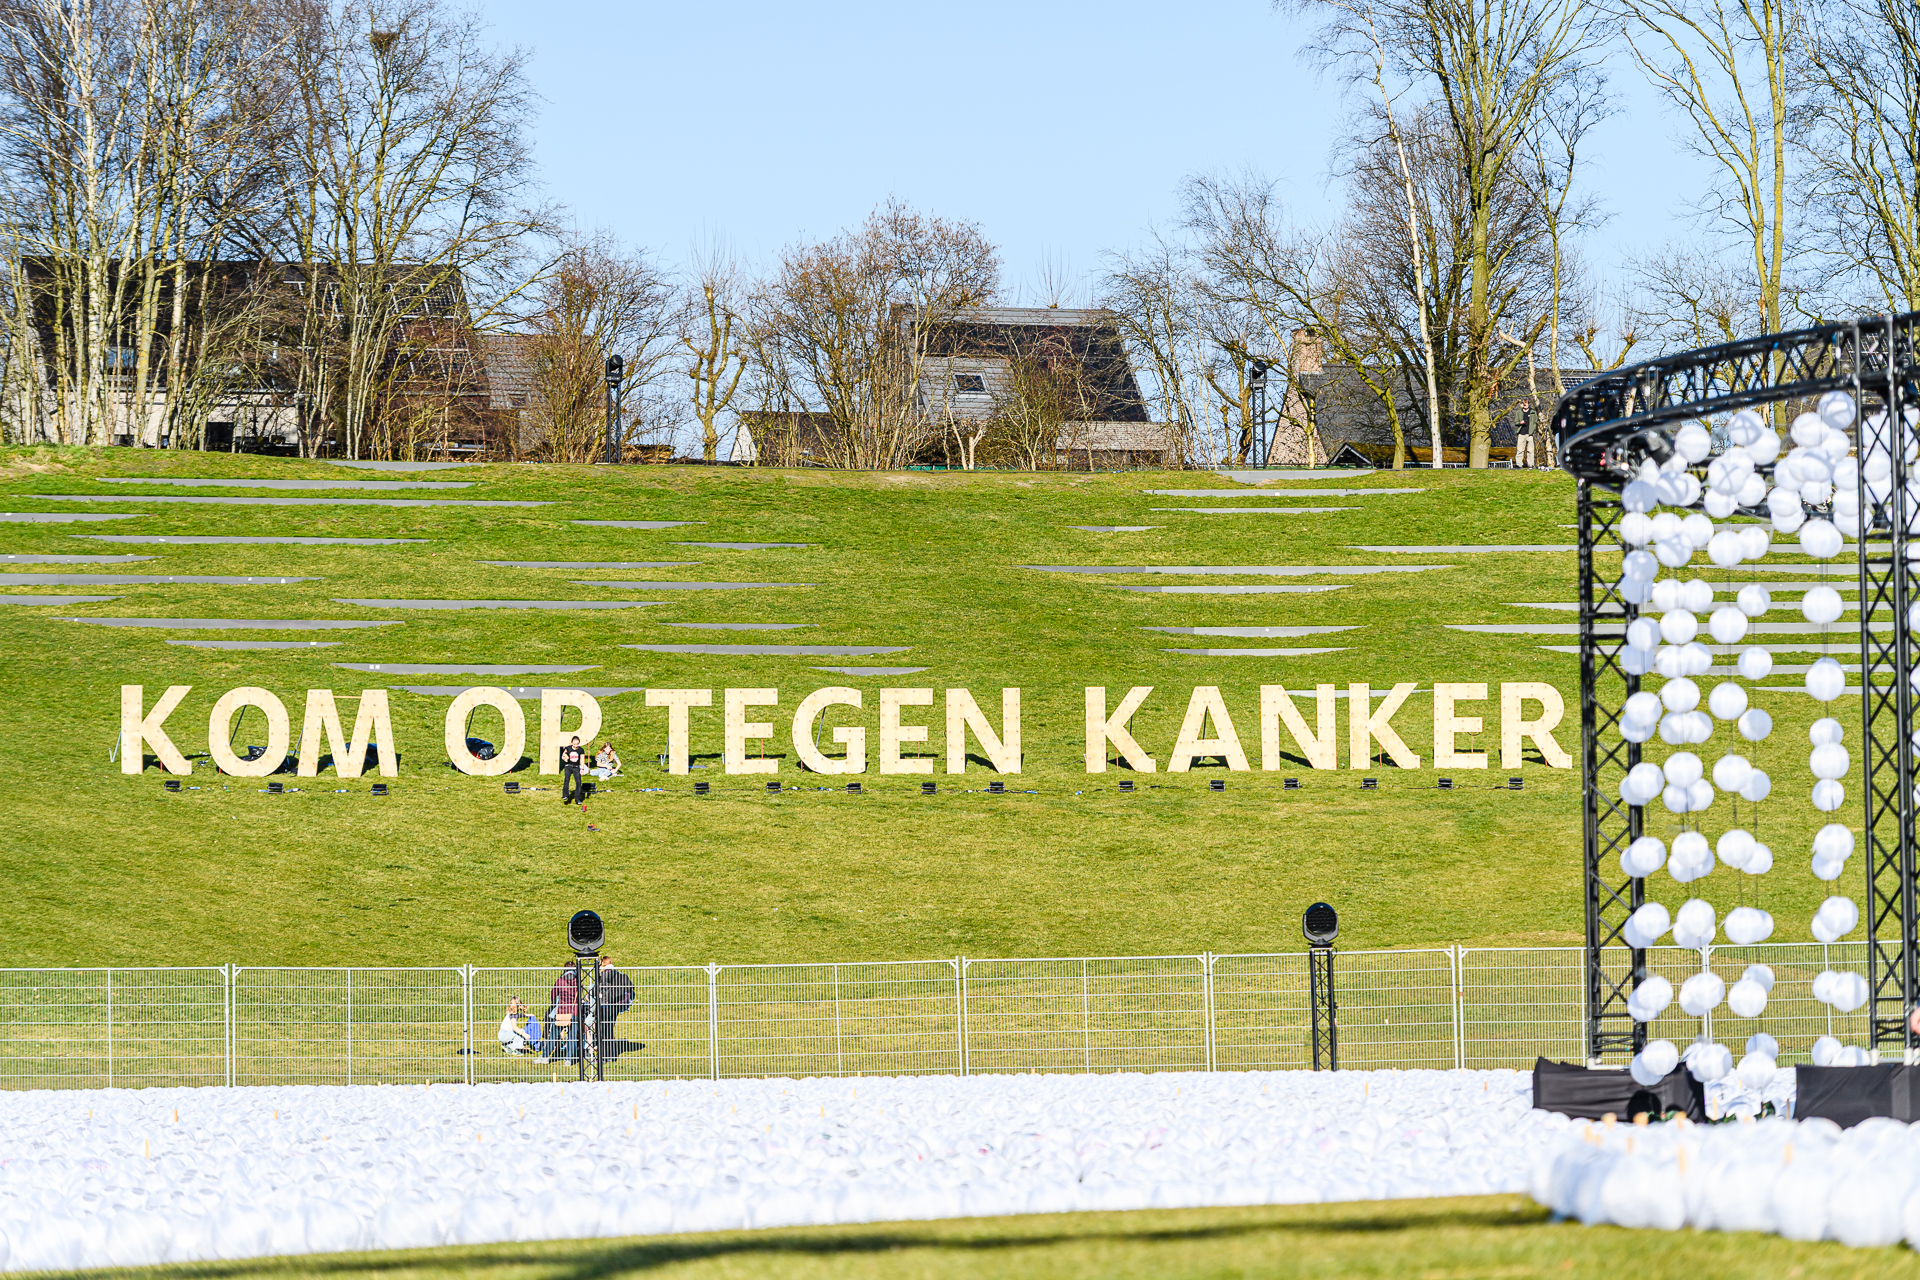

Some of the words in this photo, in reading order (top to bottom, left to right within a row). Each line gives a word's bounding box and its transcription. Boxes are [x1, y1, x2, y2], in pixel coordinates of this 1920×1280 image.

[121, 685, 398, 777] KOM
[445, 686, 602, 776] OP
[645, 687, 1022, 775] TEGEN
[1085, 682, 1572, 773] KANKER
